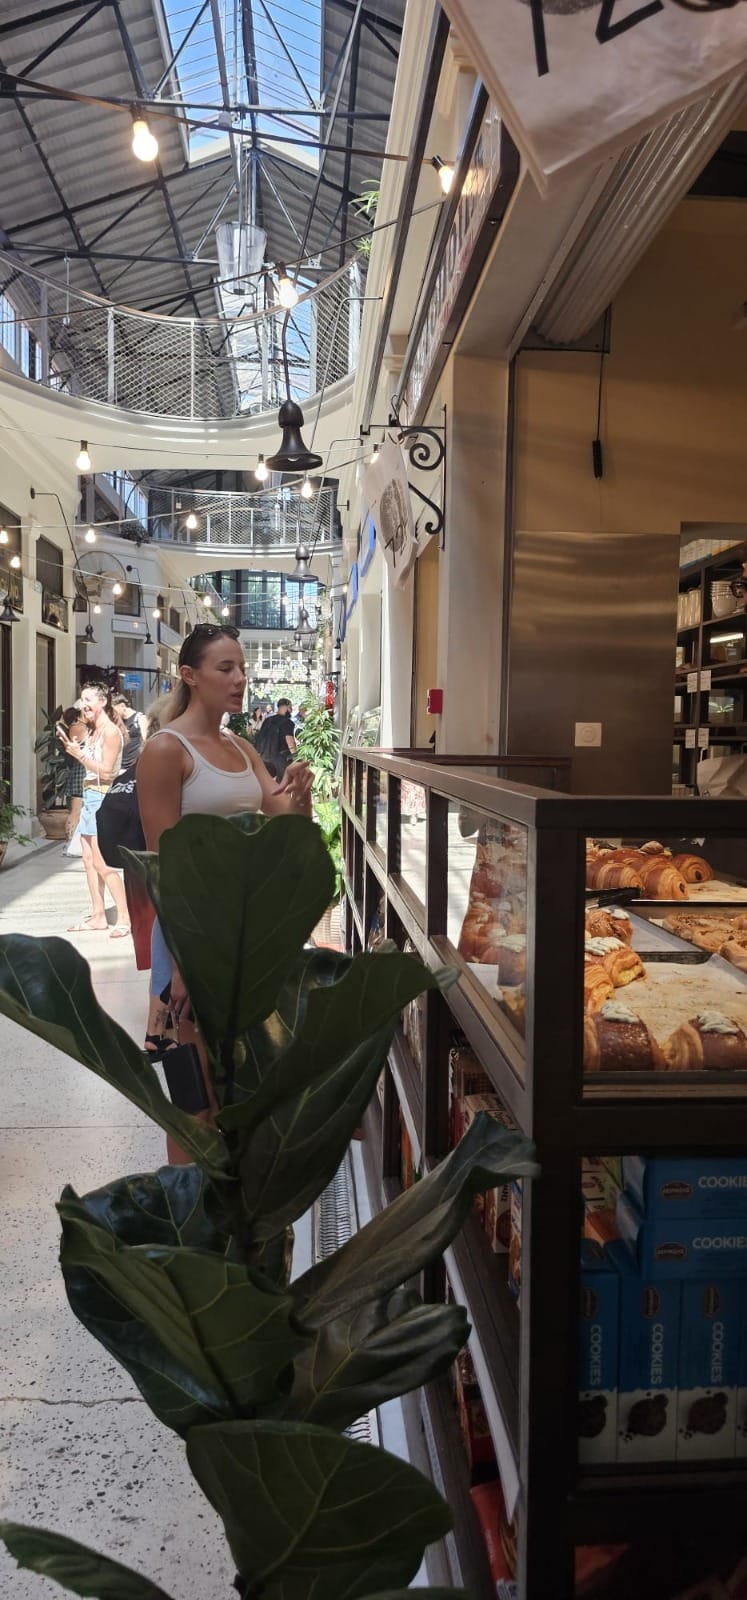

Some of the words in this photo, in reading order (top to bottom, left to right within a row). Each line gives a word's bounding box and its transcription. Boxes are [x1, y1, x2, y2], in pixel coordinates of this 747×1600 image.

[590, 1324, 602, 1386] COOKIES
[651, 1323, 664, 1385] COOKIES
[711, 1321, 724, 1383] COOKIES
